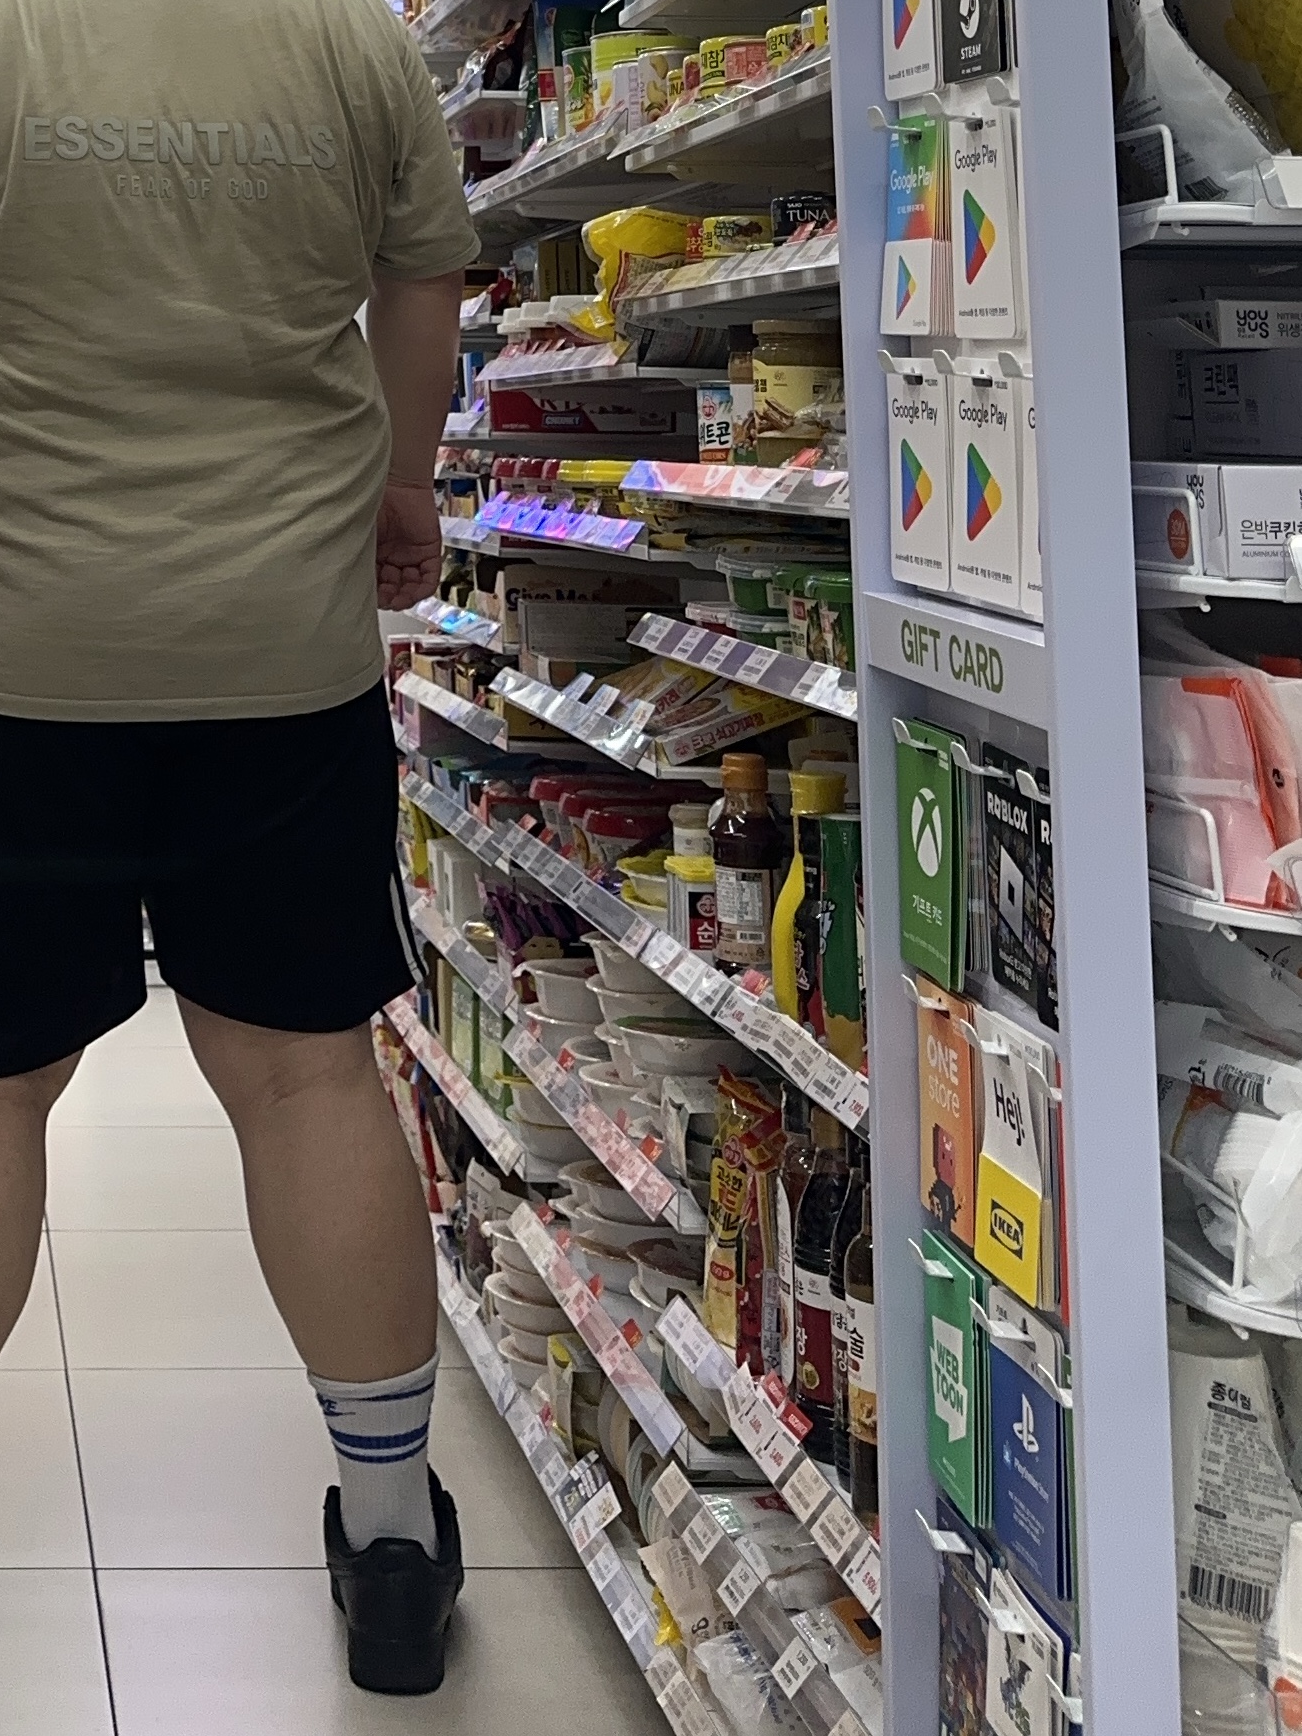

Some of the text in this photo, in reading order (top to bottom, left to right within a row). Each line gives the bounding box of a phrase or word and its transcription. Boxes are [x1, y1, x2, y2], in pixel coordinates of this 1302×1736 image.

[960, 44, 982, 60] STEAM
[24, 115, 337, 169] ESSENTIALS
[955, 144, 997, 172] Google Play
[117, 175, 268, 200] FEAR OF GOD
[891, 165, 933, 194] Google Play
[787, 209, 830, 222] TUNA
[892, 398, 938, 426] Google Play
[958, 400, 1008, 431] Google Play
[901, 620, 1004, 694] GIFT CARD
[986, 790, 1029, 835] ROBLOX
[926, 1033, 959, 1087] ONE
[928, 1075, 960, 1119] store
[993, 1077, 1026, 1147] Hej!
[993, 1212, 1022, 1247] IKEA
[935, 1339, 960, 1385] WEB
[934, 1366, 965, 1416] TOON
